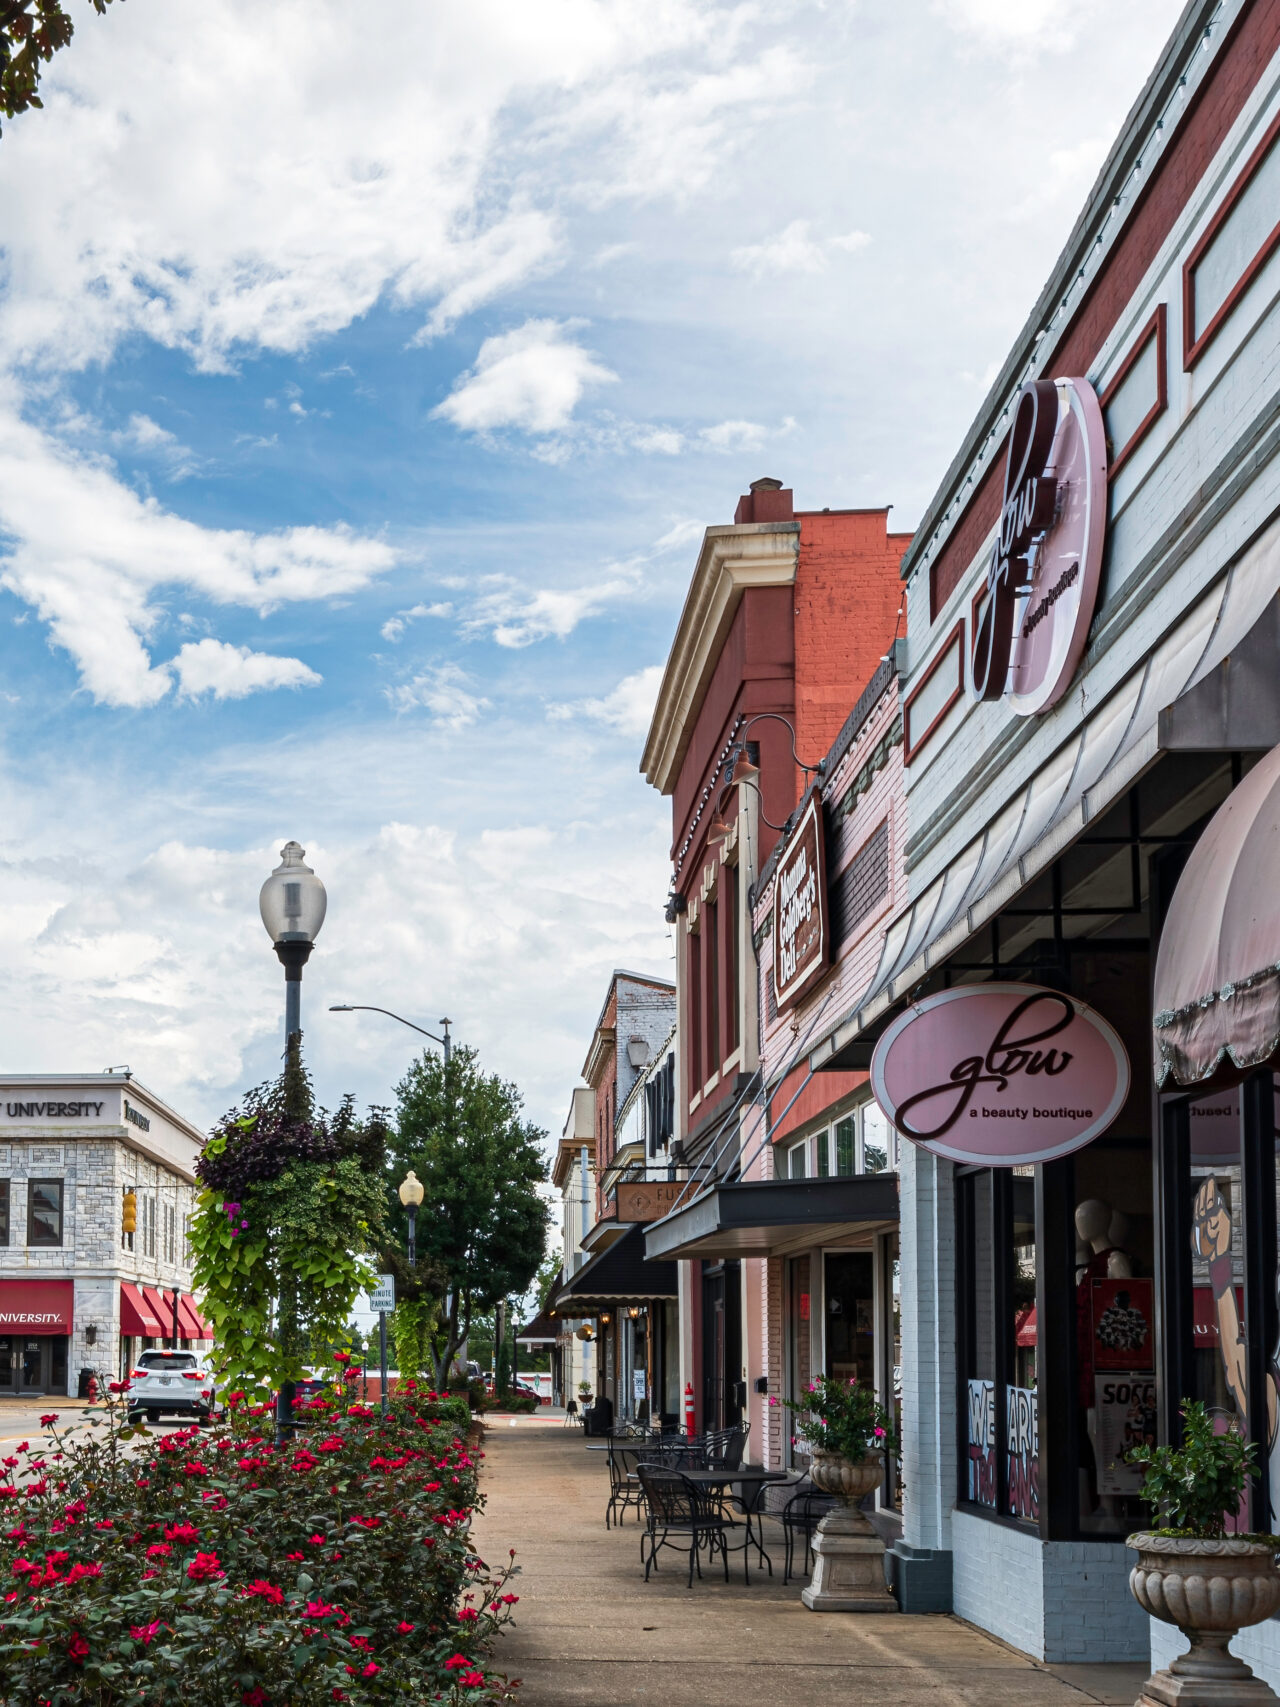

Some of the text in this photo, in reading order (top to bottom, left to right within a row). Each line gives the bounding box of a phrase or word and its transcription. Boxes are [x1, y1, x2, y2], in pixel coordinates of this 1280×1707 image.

[780, 934, 797, 988] Deli
[894, 991, 1076, 1141] glow
[7, 1102, 104, 1117] UNIVERSITY
[969, 1107, 1093, 1120] a beauty boutique
[657, 1188, 693, 1201] FUSE
[371, 1300, 392, 1308] PARKING
[969, 1382, 995, 1446] WE
[1008, 1388, 1039, 1459] ARE
